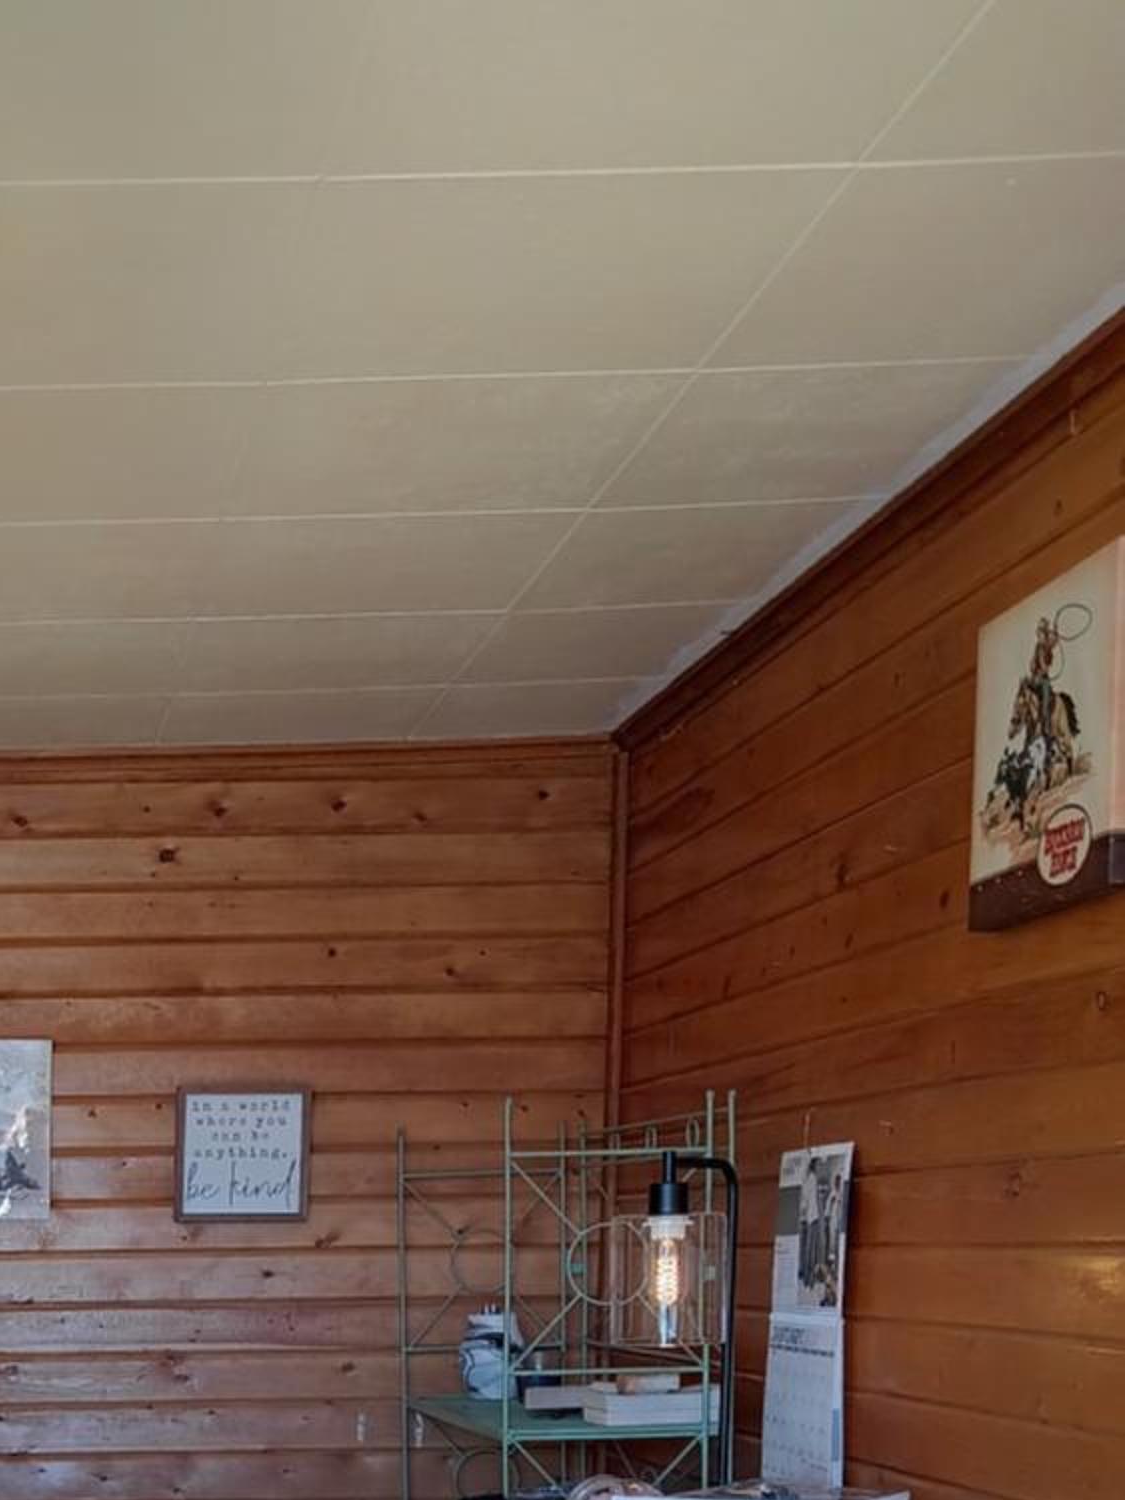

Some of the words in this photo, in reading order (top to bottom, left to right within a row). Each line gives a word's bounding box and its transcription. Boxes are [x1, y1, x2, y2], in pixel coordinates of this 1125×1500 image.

[196, 1116, 246, 1126] where
[256, 1116, 287, 1129] you
[228, 1158, 297, 1208] kind
